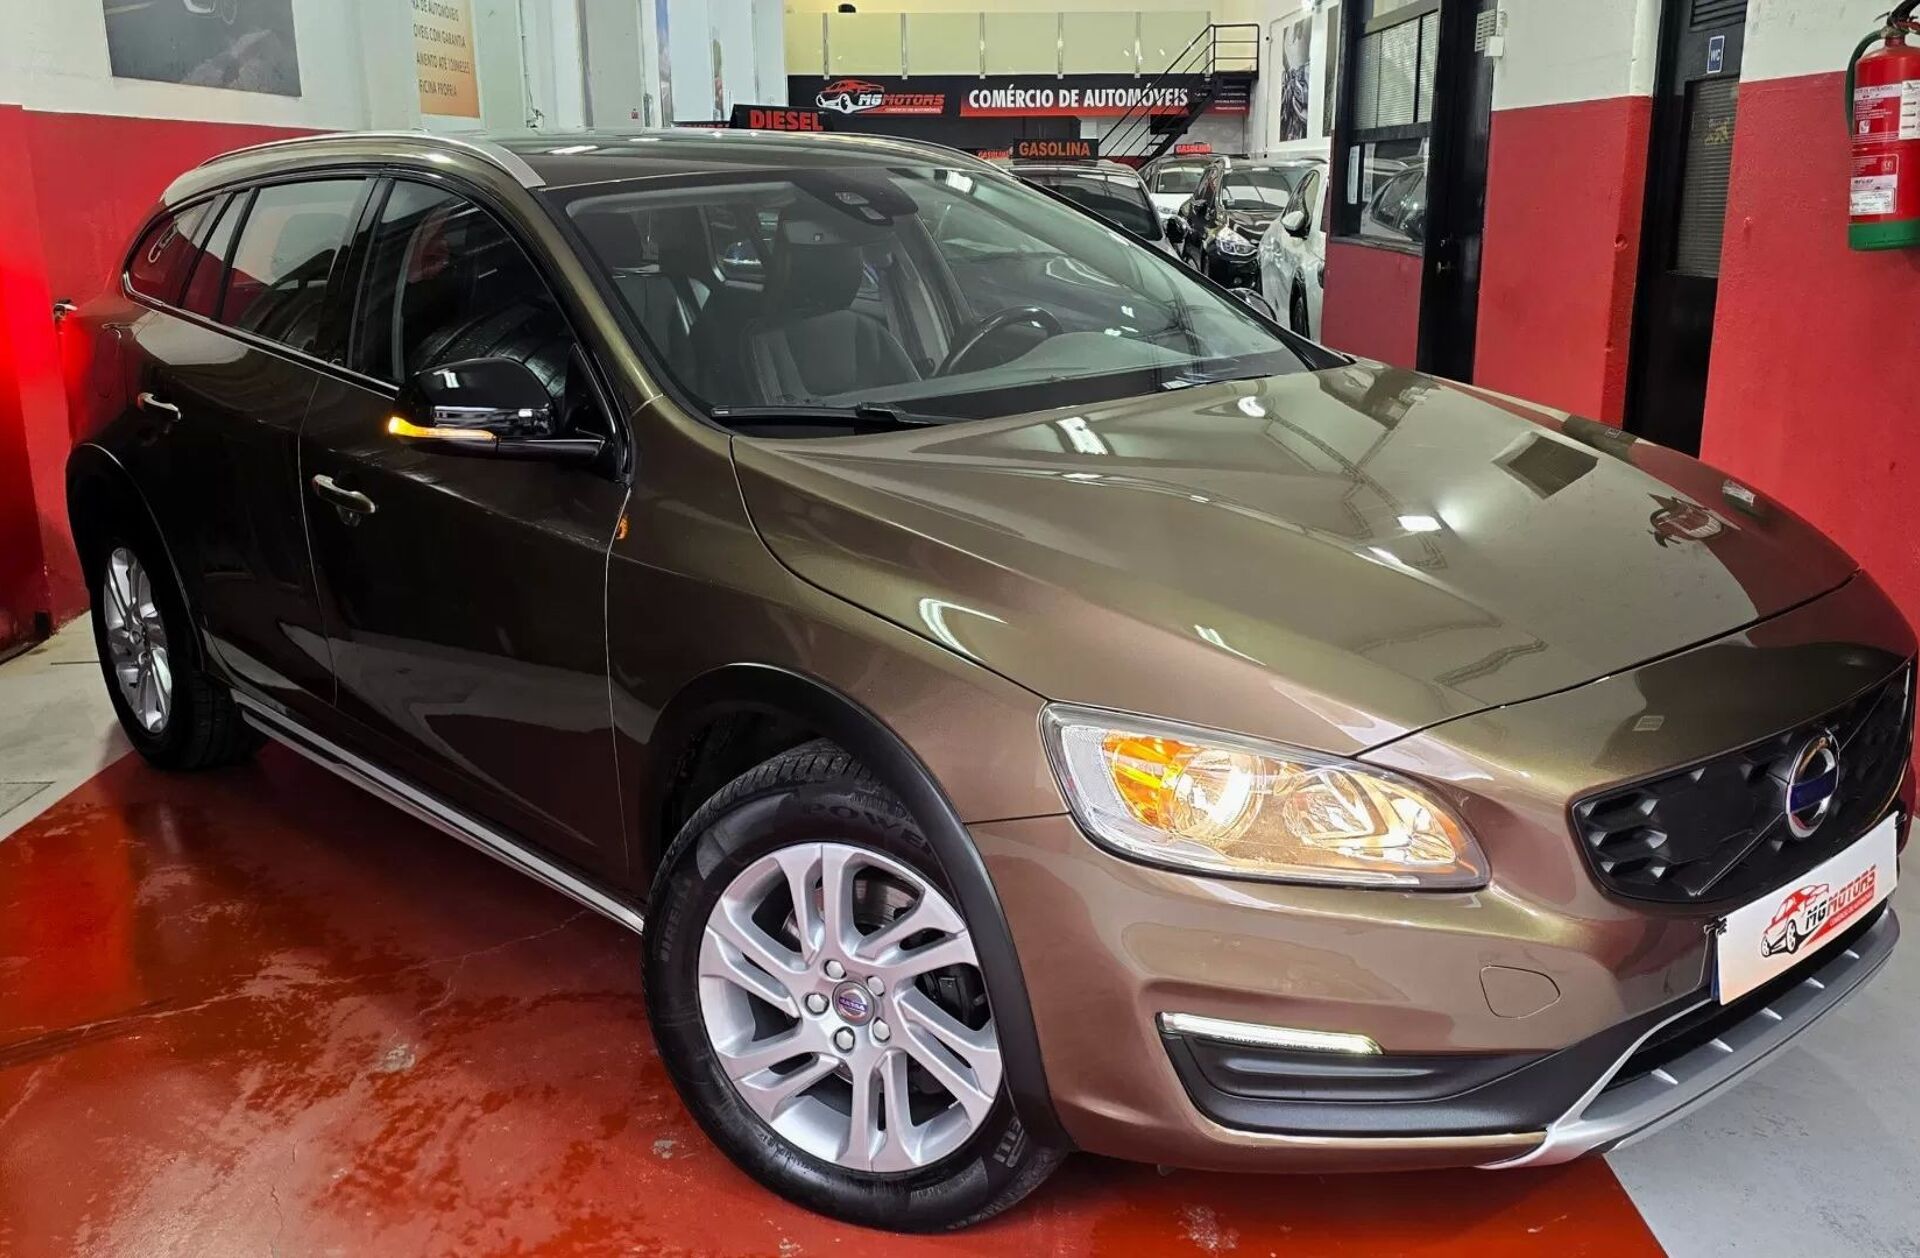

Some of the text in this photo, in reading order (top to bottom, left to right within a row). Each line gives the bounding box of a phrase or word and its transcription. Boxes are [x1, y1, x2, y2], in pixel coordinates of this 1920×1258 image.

[441, 30, 467, 48] GARANTIA
[1710, 48, 1721, 62] WC
[969, 84, 1188, 108] COMÉRCIO DE AUTOMÓVEIS
[750, 109, 823, 131] DIESEL
[1019, 142, 1091, 158] GASOLINA
